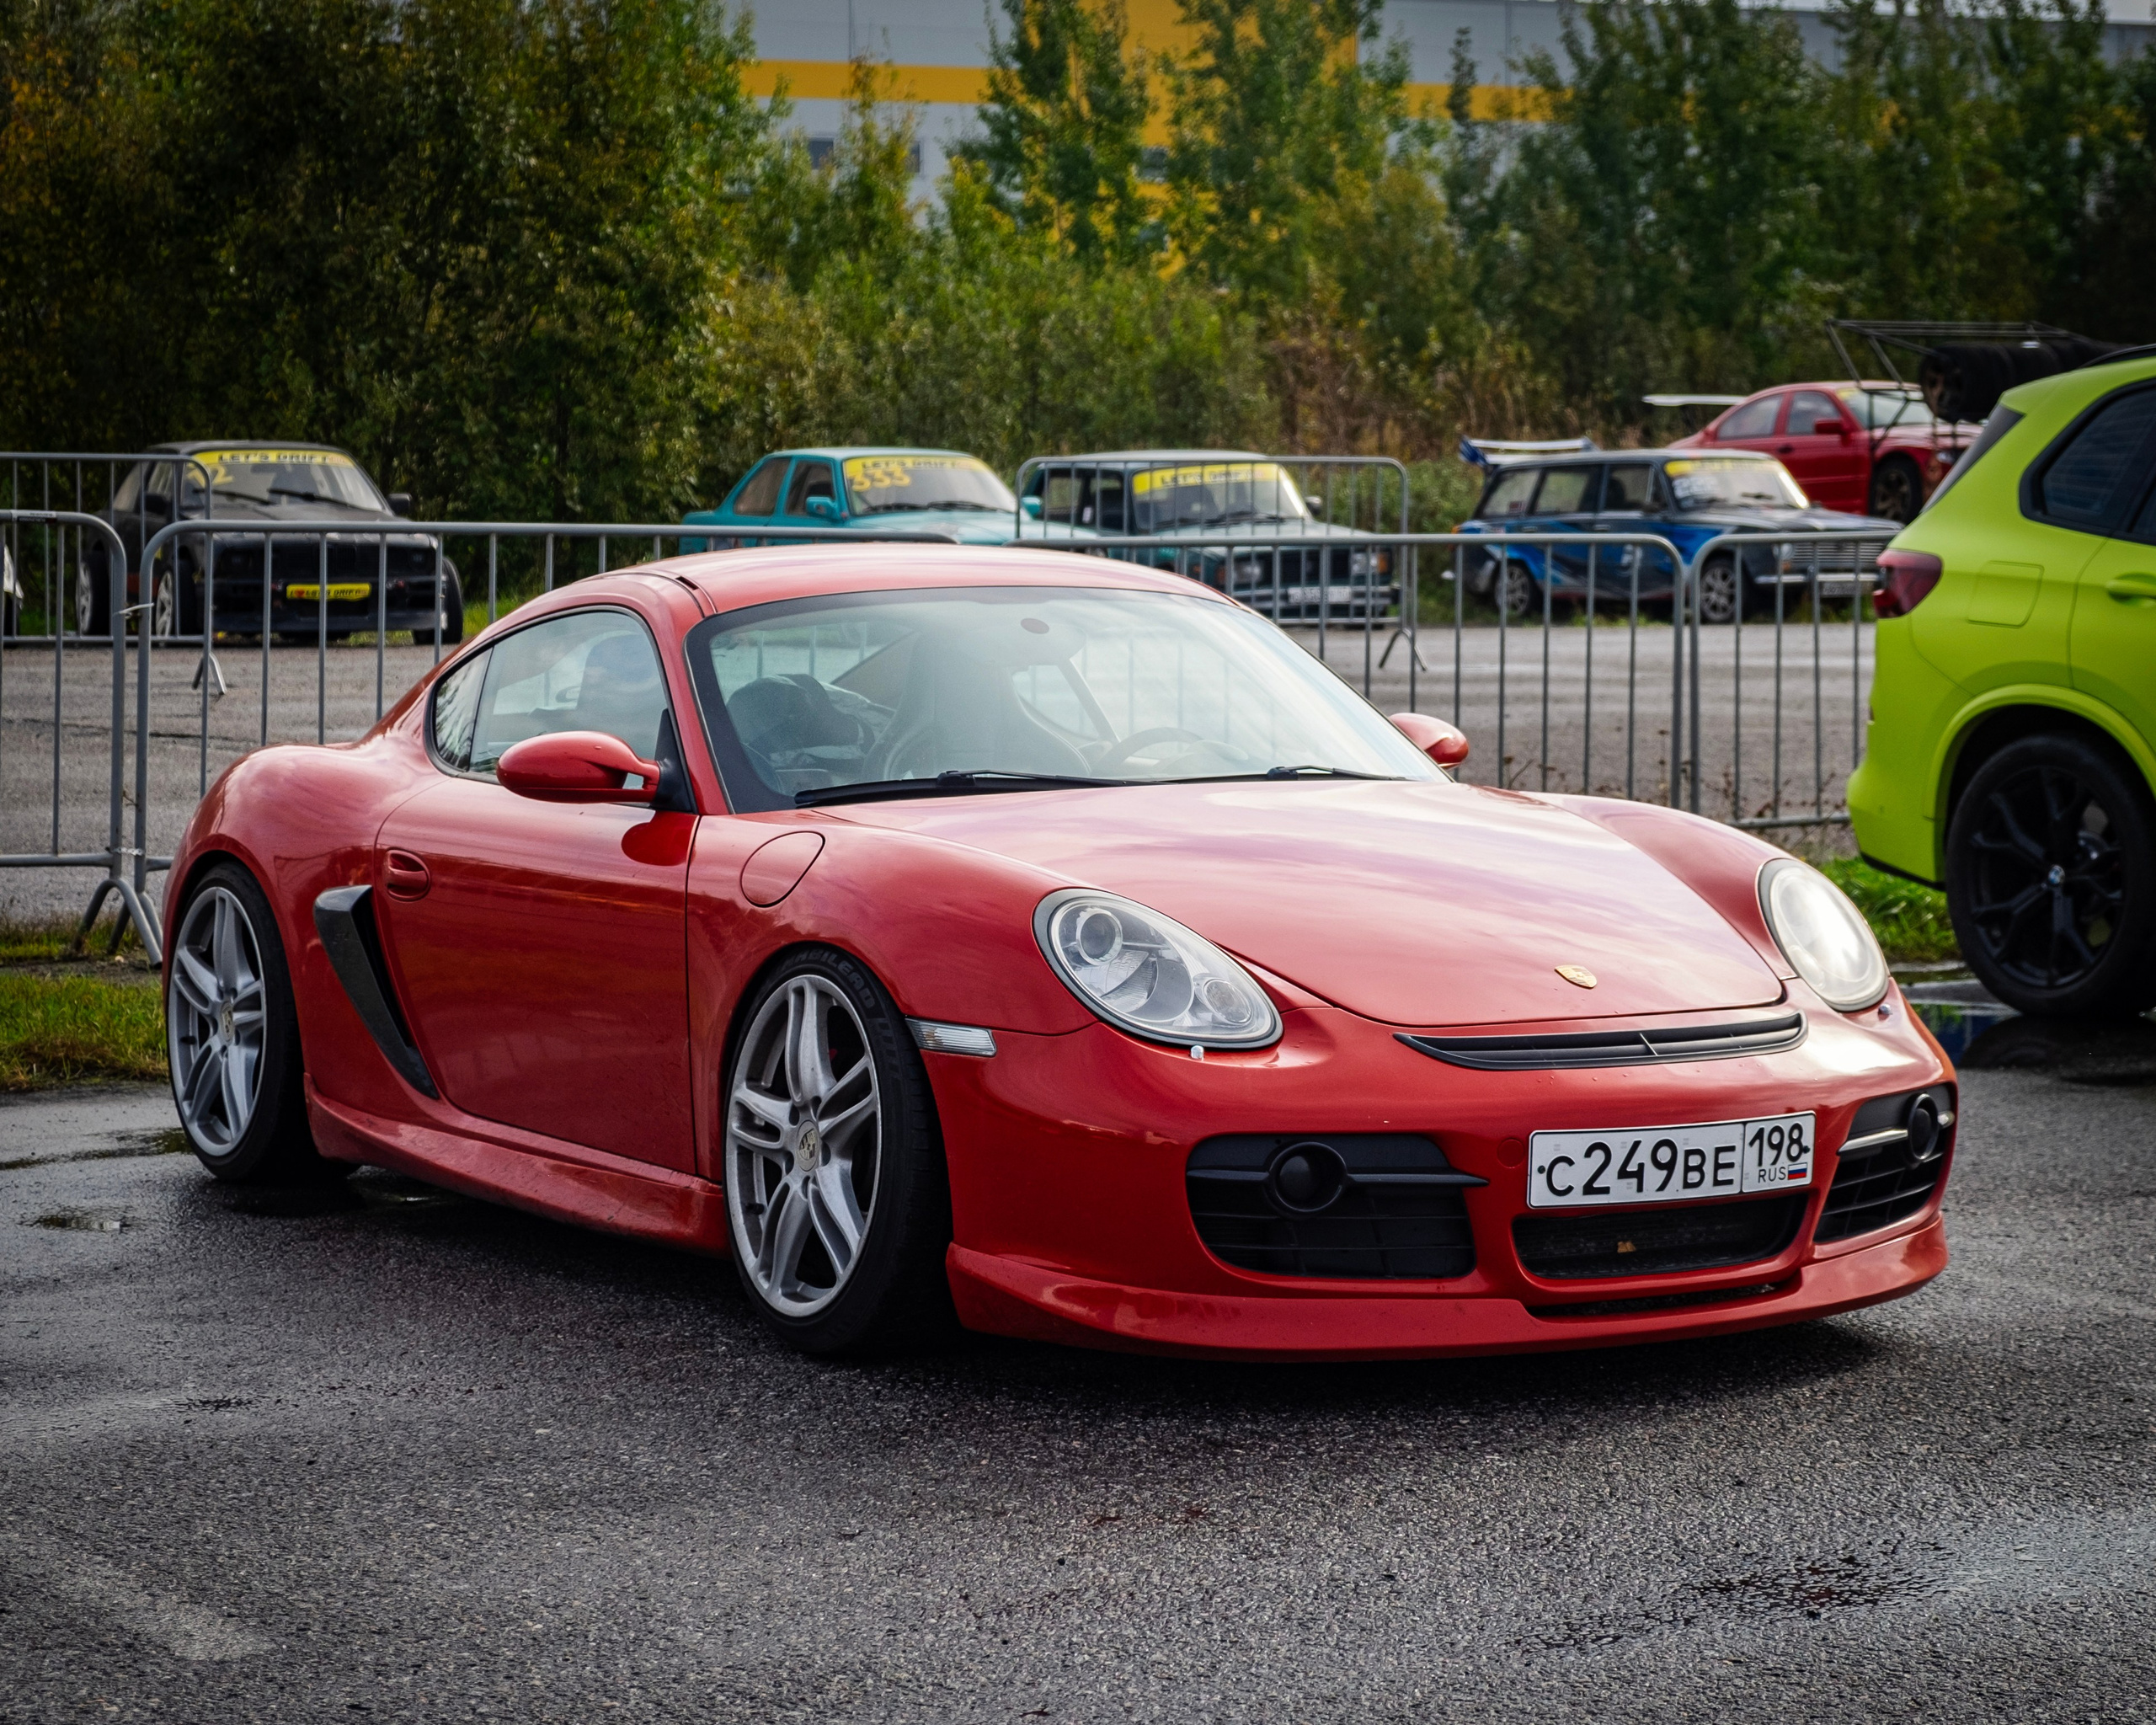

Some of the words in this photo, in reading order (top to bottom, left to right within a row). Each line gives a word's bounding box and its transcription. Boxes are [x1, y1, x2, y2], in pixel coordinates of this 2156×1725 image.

[1545, 1138, 1737, 1197] C249BE
[1748, 1122, 1804, 1167] 198
[1758, 1166, 1786, 1183] RUS
